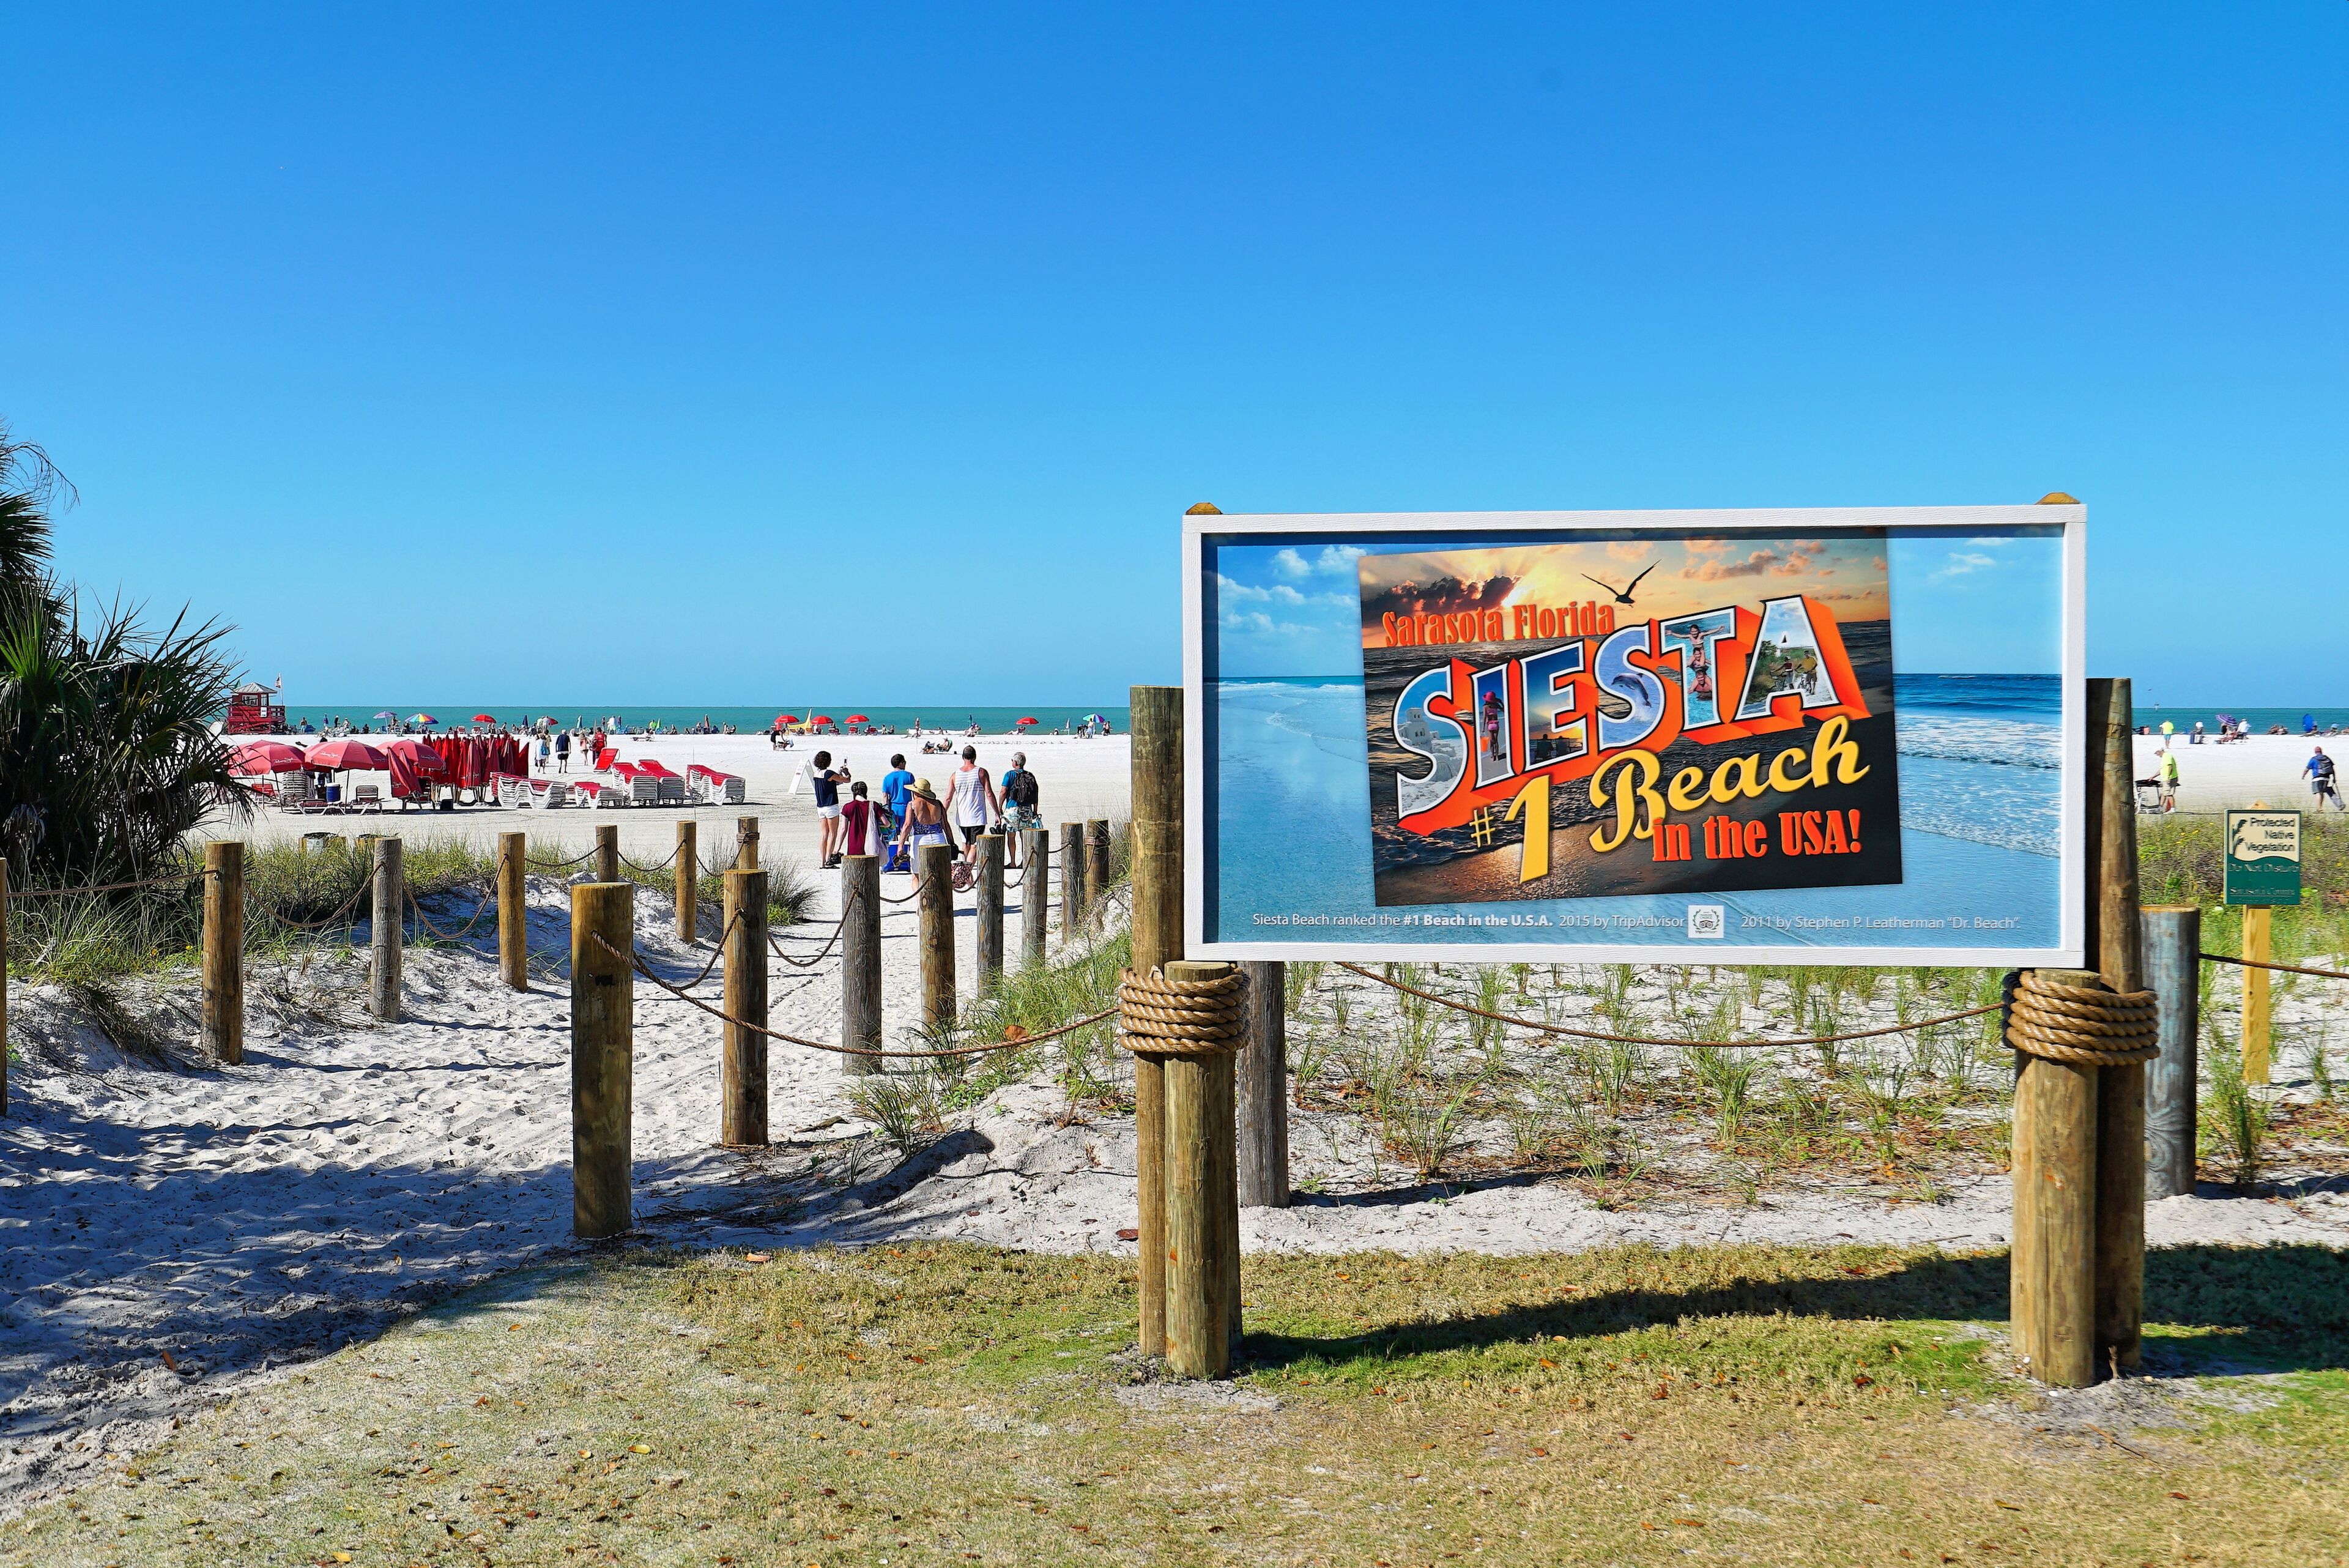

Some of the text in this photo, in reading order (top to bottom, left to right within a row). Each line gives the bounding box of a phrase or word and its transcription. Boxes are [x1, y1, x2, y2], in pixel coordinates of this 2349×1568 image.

[1382, 601, 1614, 647] Sarasota Florida
[1392, 594, 1842, 822] SIESTA
[1588, 715, 1870, 852] Beach
[2250, 817, 2295, 827] Protected
[1652, 809, 1862, 861] in the USA!
[2265, 830, 2294, 839] Native
[2245, 842, 2295, 853] Vegetation
[1253, 913, 1685, 930] Siesta Beach ranked the #1 Beach in the U.S.A. 2015 by TripAdvisor
[1742, 916, 1771, 928] 2011
[1776, 916, 1792, 930] by
[1794, 915, 1849, 930] Stephen
[1853, 916, 1862, 928] P.
[1866, 916, 1944, 929] Leatherman
